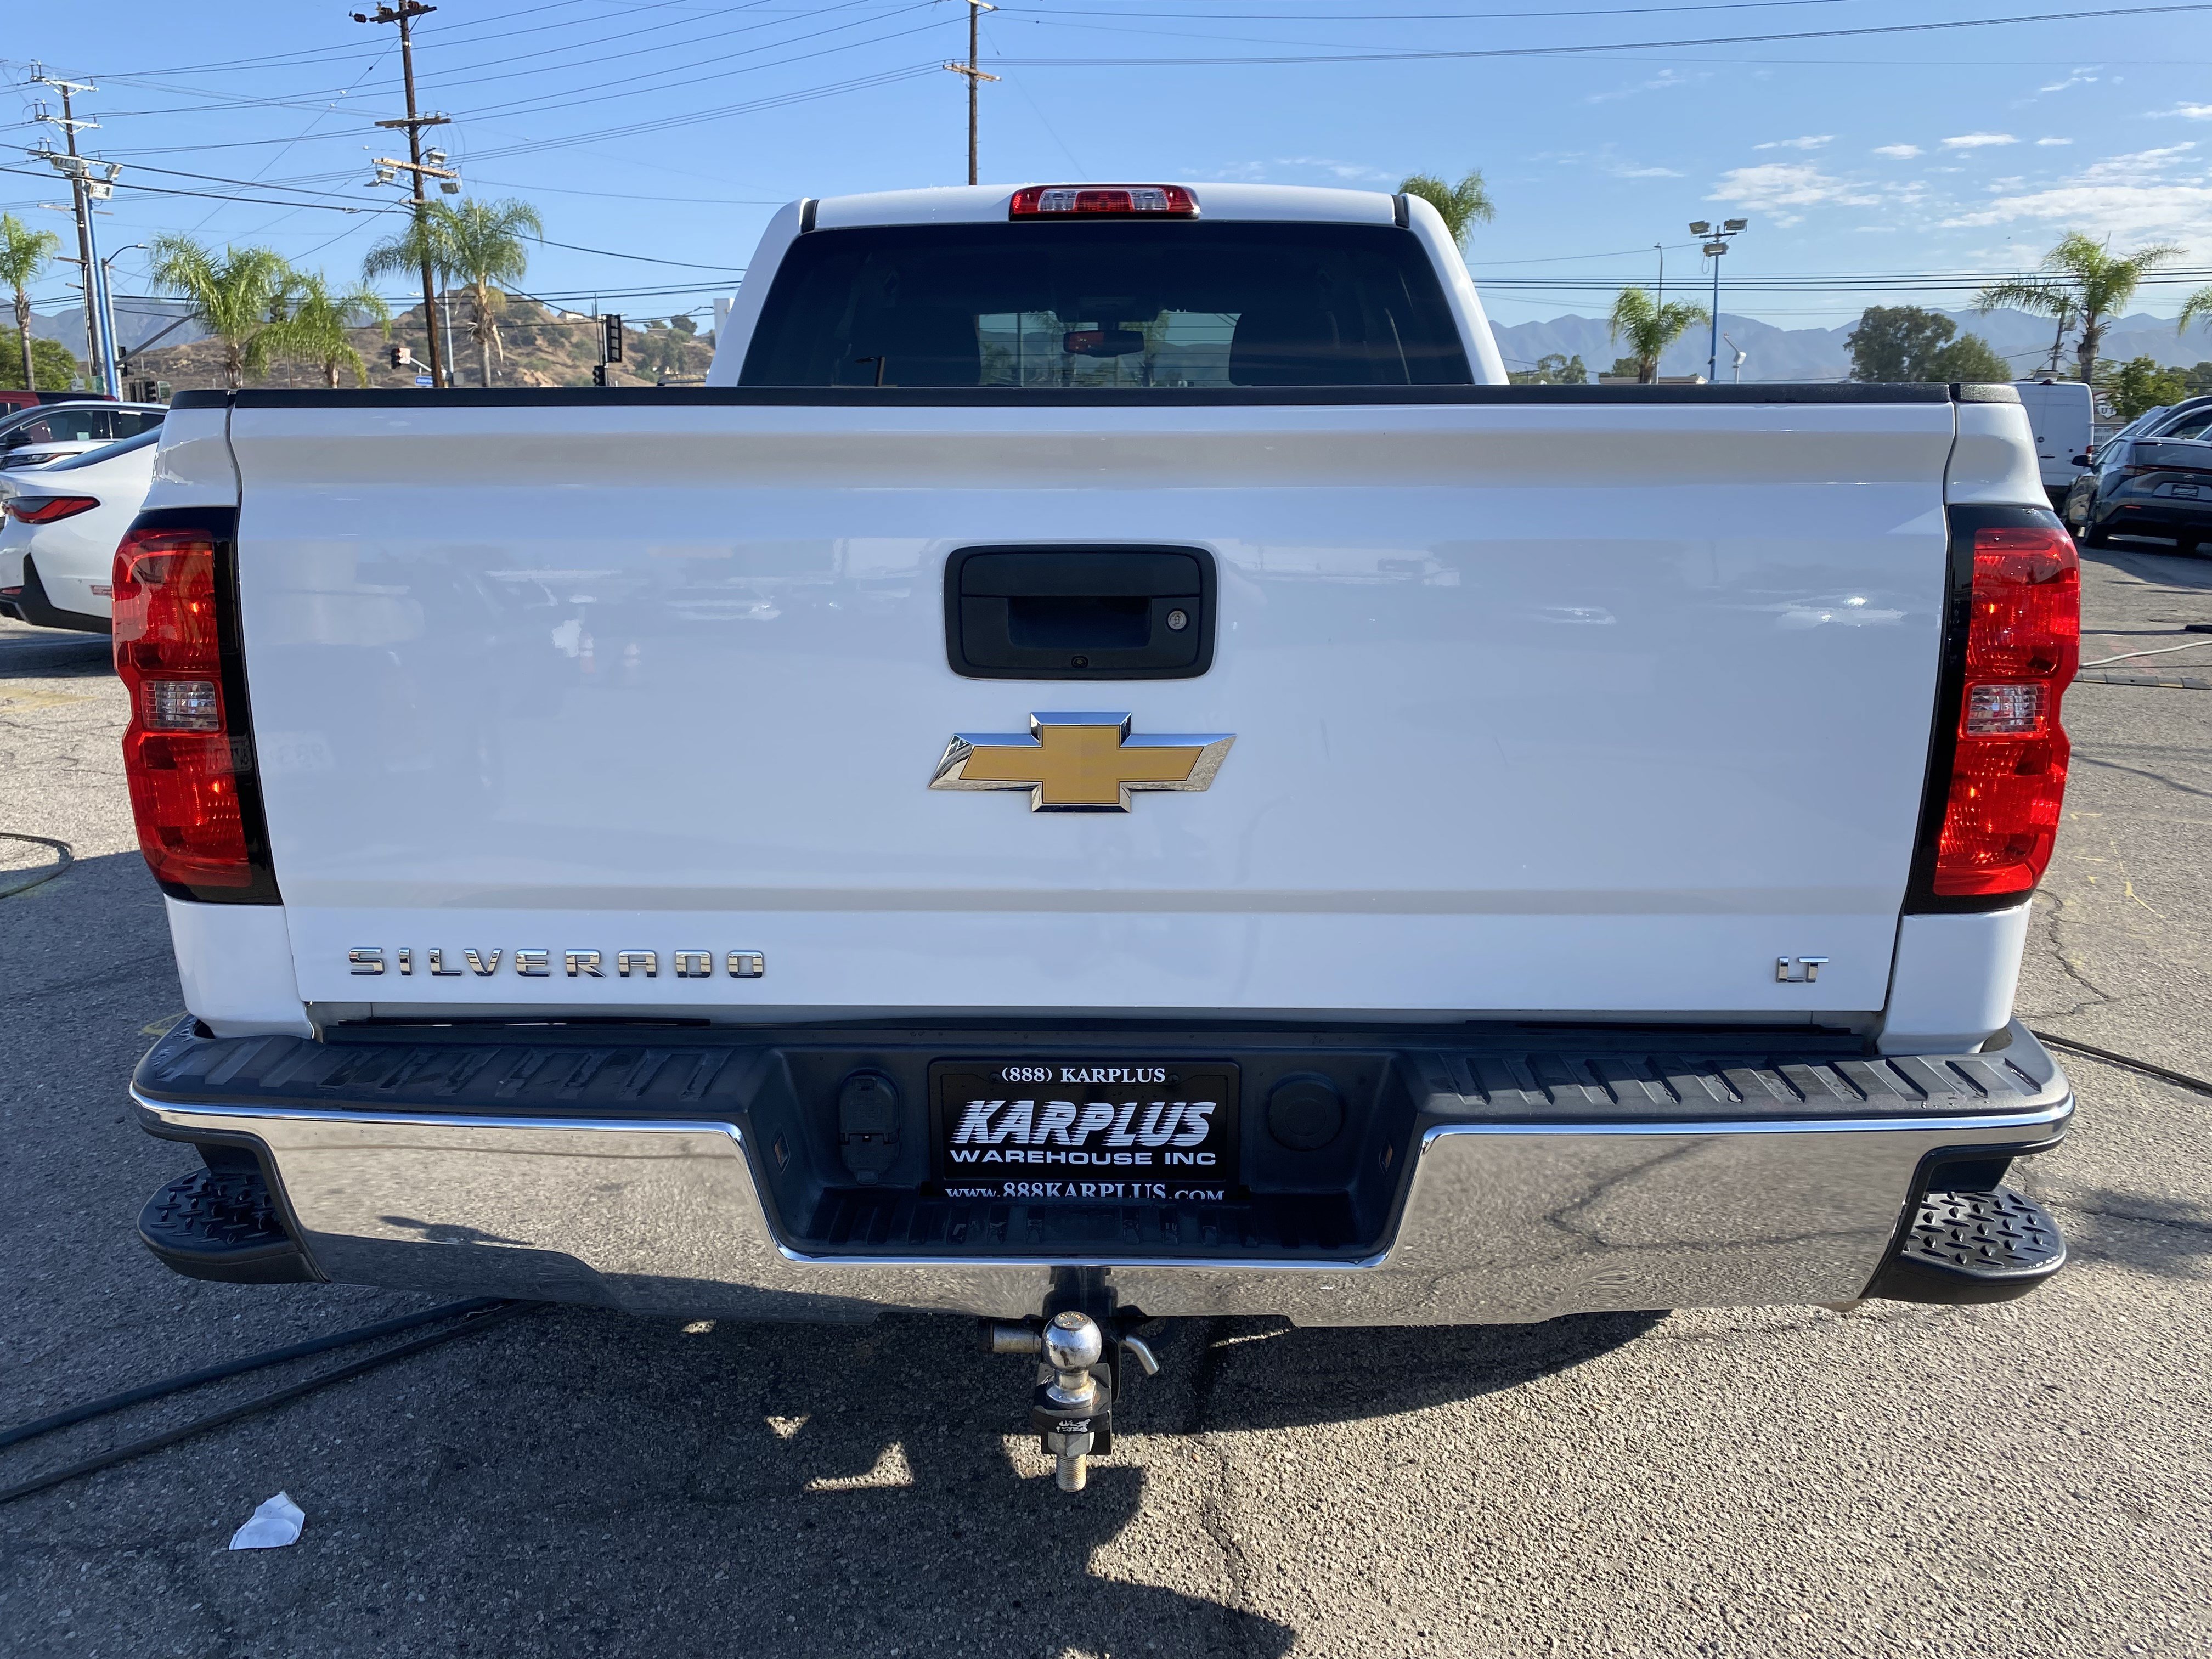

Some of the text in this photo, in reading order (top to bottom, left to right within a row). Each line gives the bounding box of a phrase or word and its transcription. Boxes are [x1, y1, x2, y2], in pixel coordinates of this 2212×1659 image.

[348, 947, 765, 978] SILVERADO
[1776, 956, 1829, 983] LT
[1002, 1067, 1165, 1083] (888) KARPLUS
[950, 1099, 1217, 1147] KARPLUS
[950, 1150, 1216, 1166] WAREHOUSE INC
